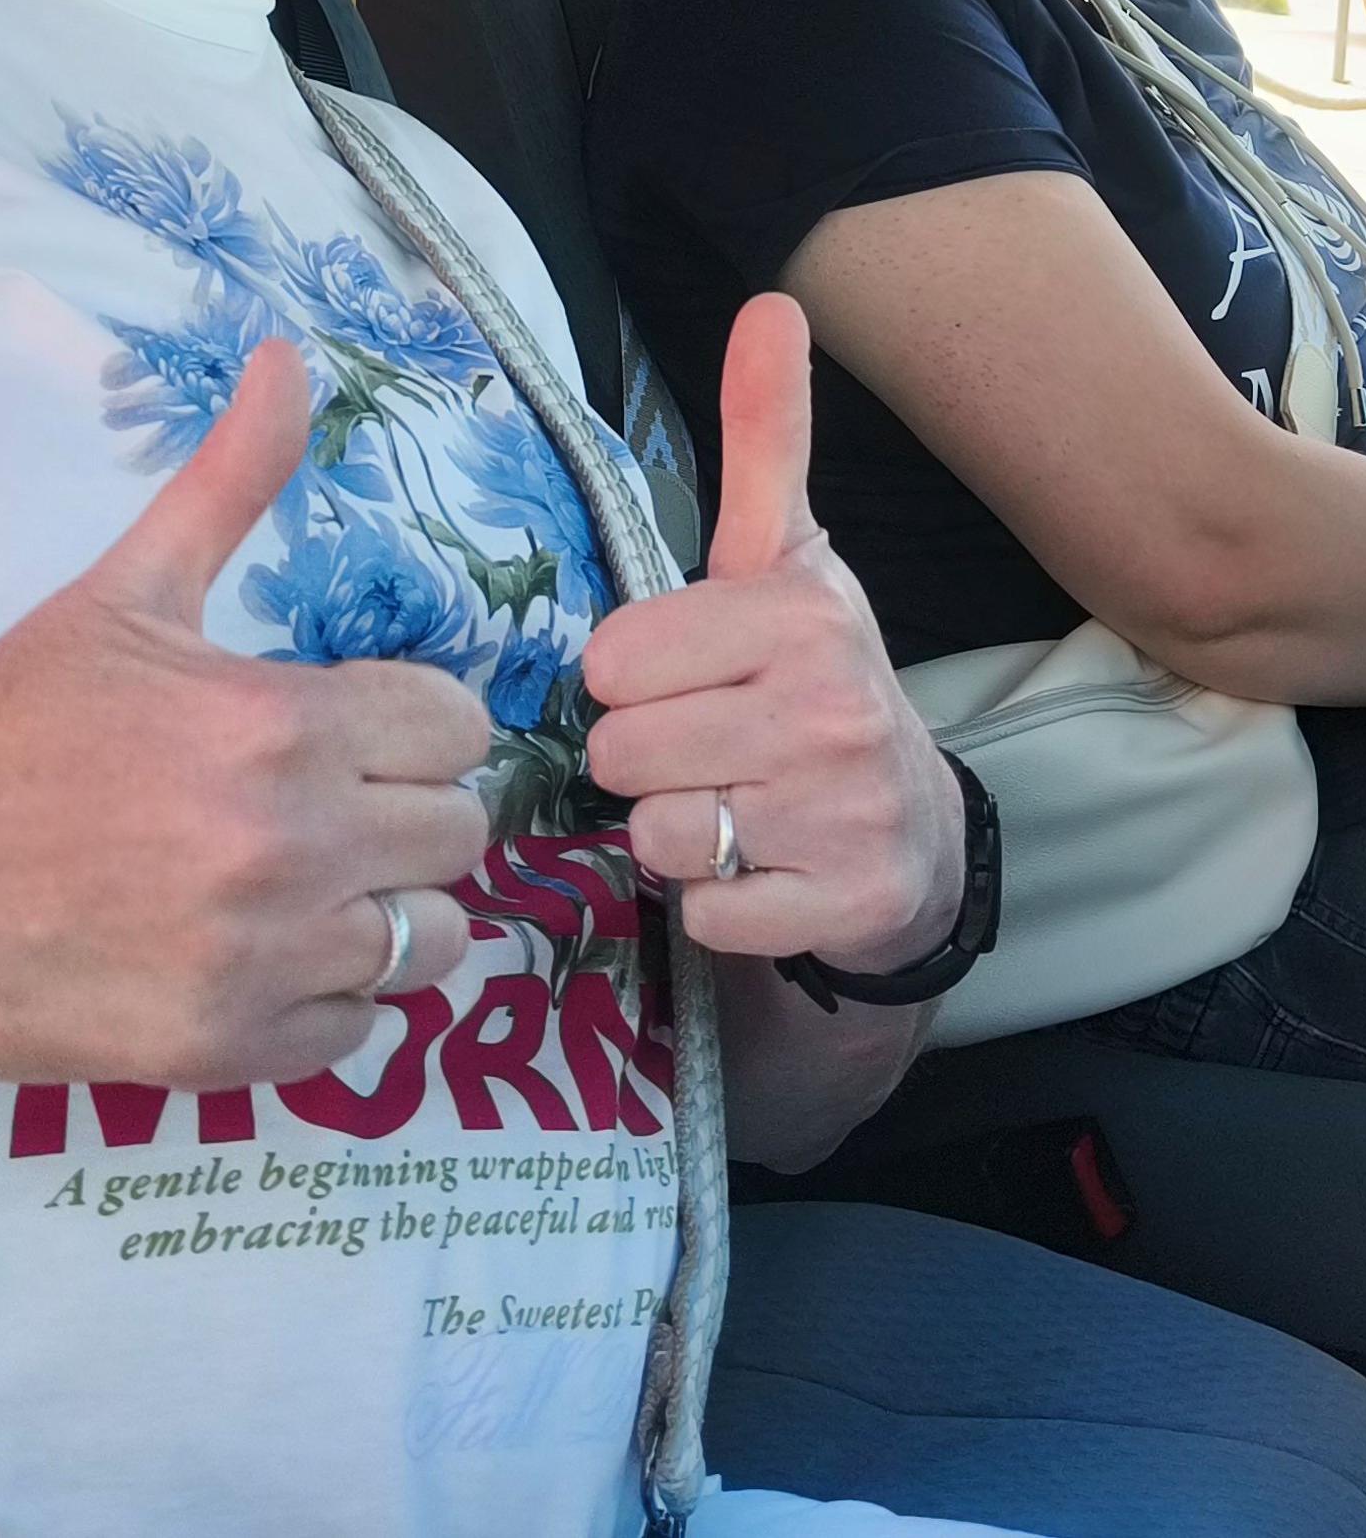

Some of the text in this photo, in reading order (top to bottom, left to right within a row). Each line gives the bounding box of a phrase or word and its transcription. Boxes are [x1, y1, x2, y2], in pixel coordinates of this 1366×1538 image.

[44, 1168, 86, 1208] A
[97, 1157, 242, 1216] gentle
[258, 1148, 459, 1200] beginning
[467, 1143, 615, 1190] wrapped
[119, 1205, 371, 1261] embracing
[380, 1201, 437, 1242] the
[438, 1196, 580, 1249] peaceful
[423, 1295, 486, 1337] The
[498, 1294, 624, 1334] Sweetest
